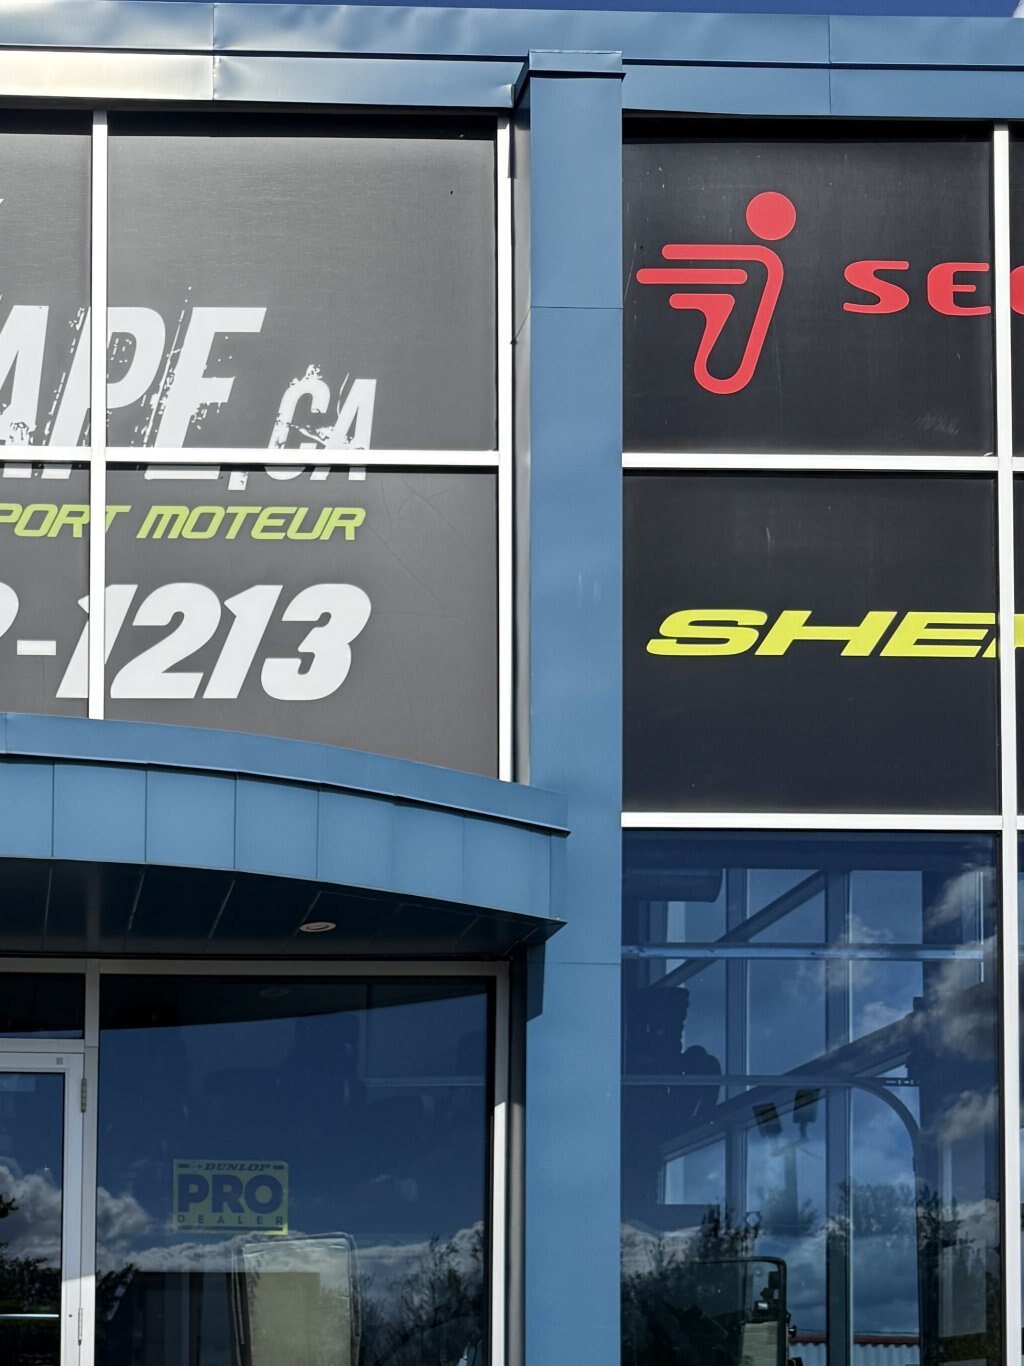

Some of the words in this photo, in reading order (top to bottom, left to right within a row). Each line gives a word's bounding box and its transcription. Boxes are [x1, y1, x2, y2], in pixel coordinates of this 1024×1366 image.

[843, 260, 1024, 316] SE
[136, 506, 367, 542] MOTEUR
[204, 1163, 271, 1172] DUNLOP
[177, 1174, 283, 1214] PRO
[177, 1215, 283, 1225] DEALER
